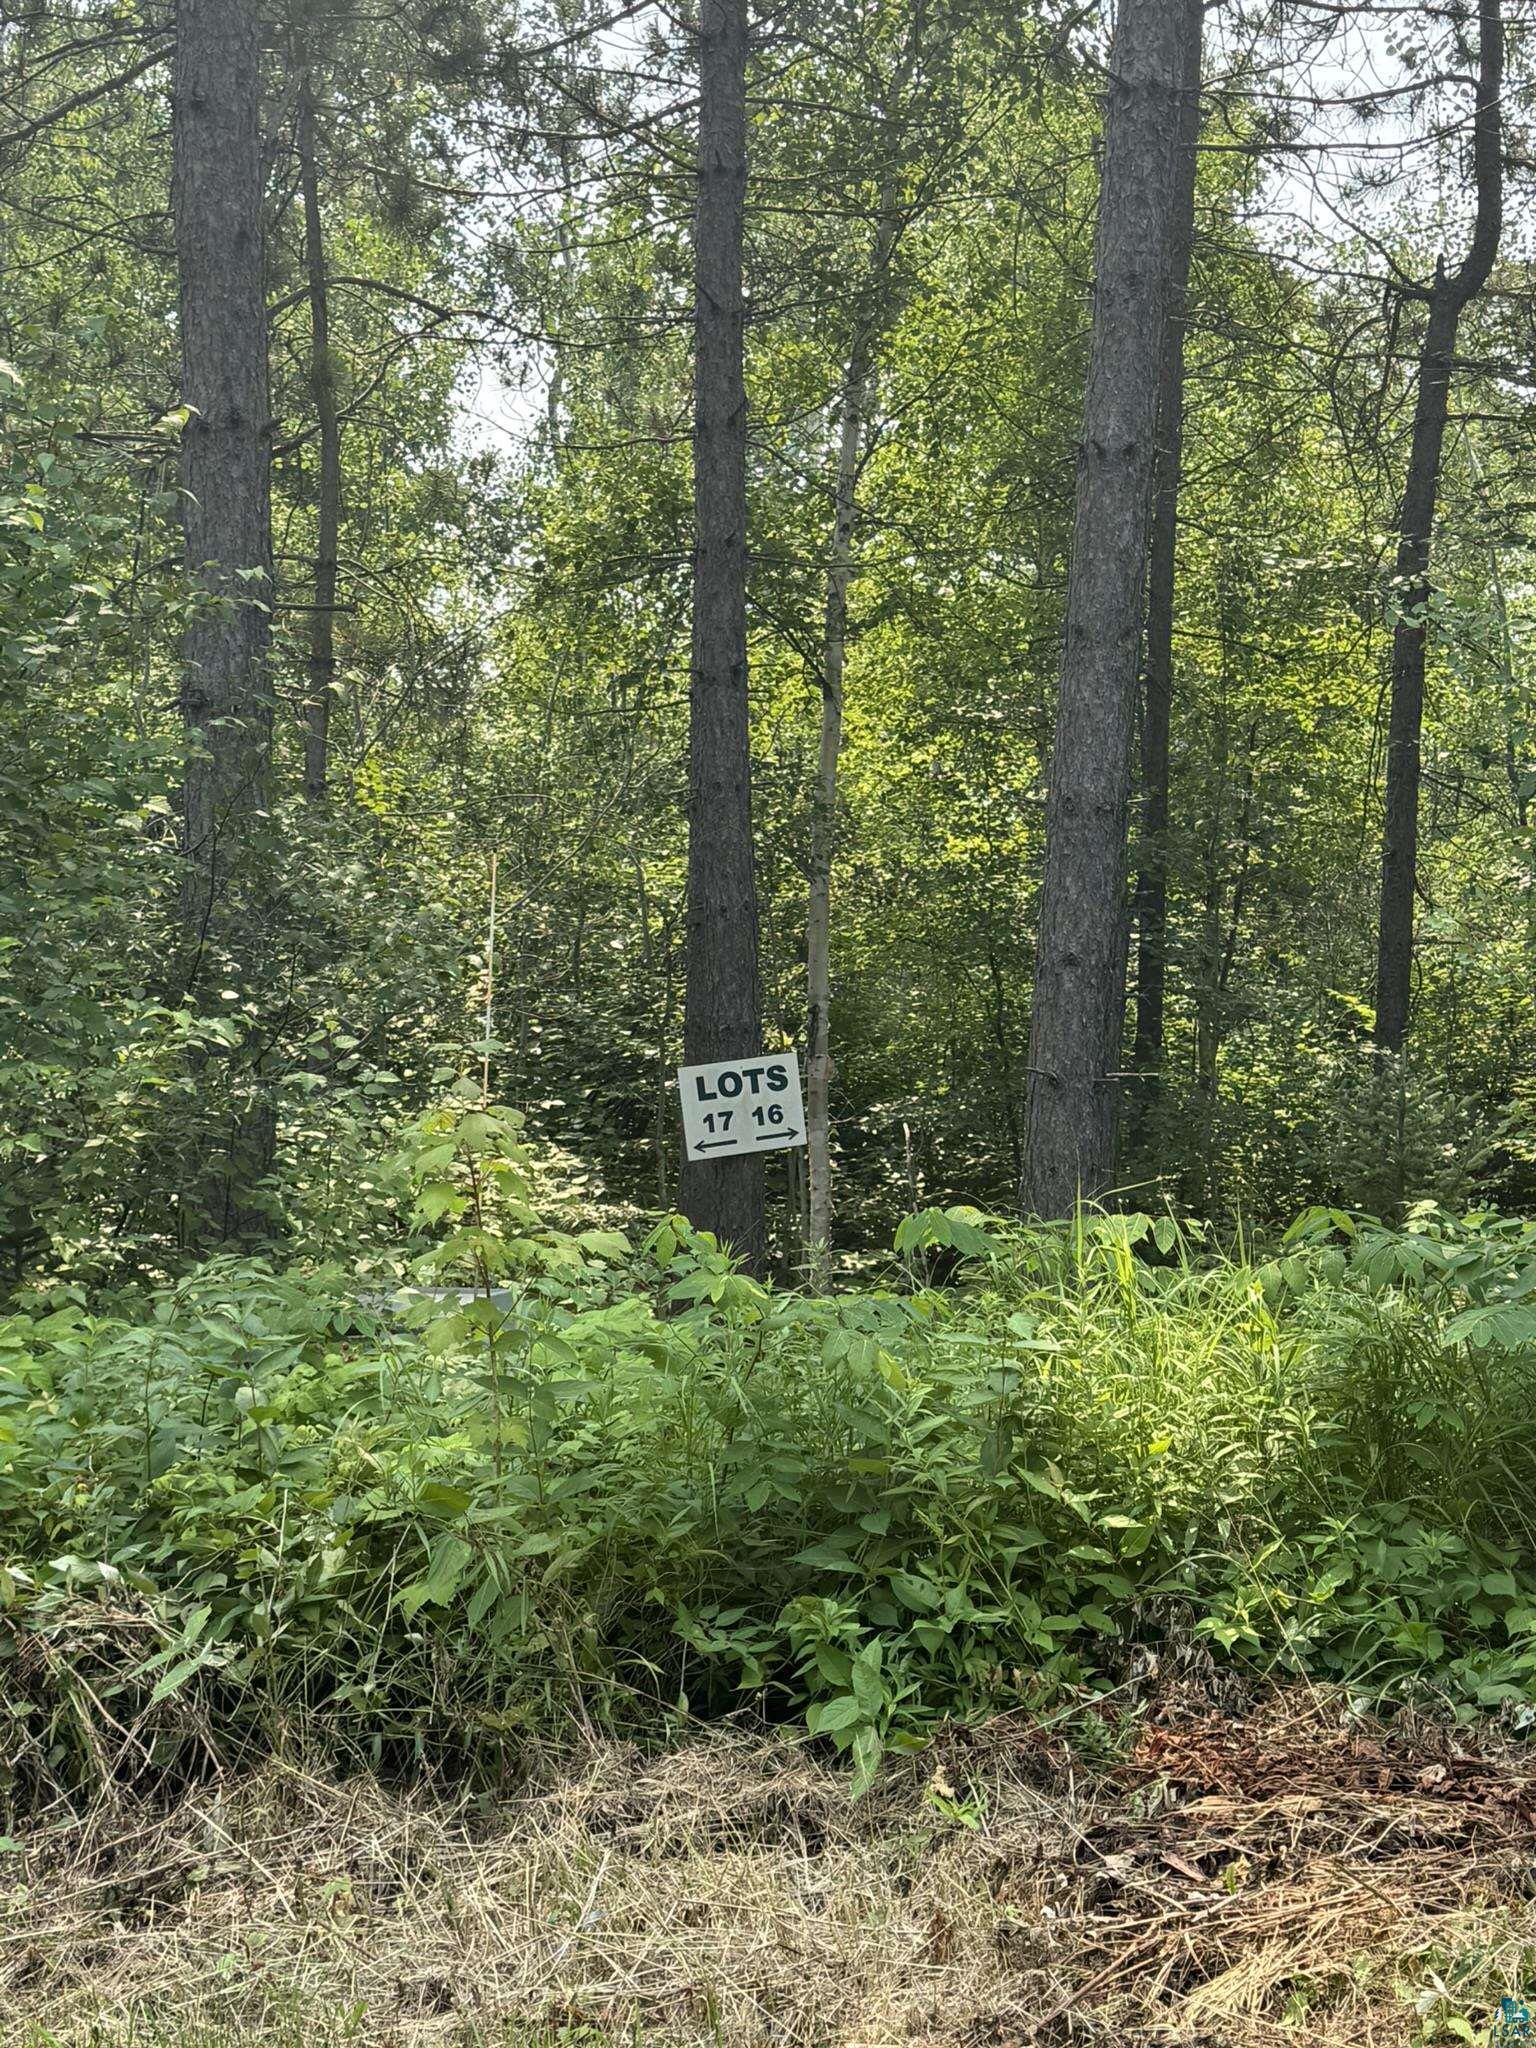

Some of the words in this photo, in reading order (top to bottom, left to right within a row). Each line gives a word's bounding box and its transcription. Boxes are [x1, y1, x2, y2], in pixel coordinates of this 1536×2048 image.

[696, 1065, 788, 1101] LOTS
[703, 1110, 733, 1133] 17
[752, 1104, 784, 1126] 16
